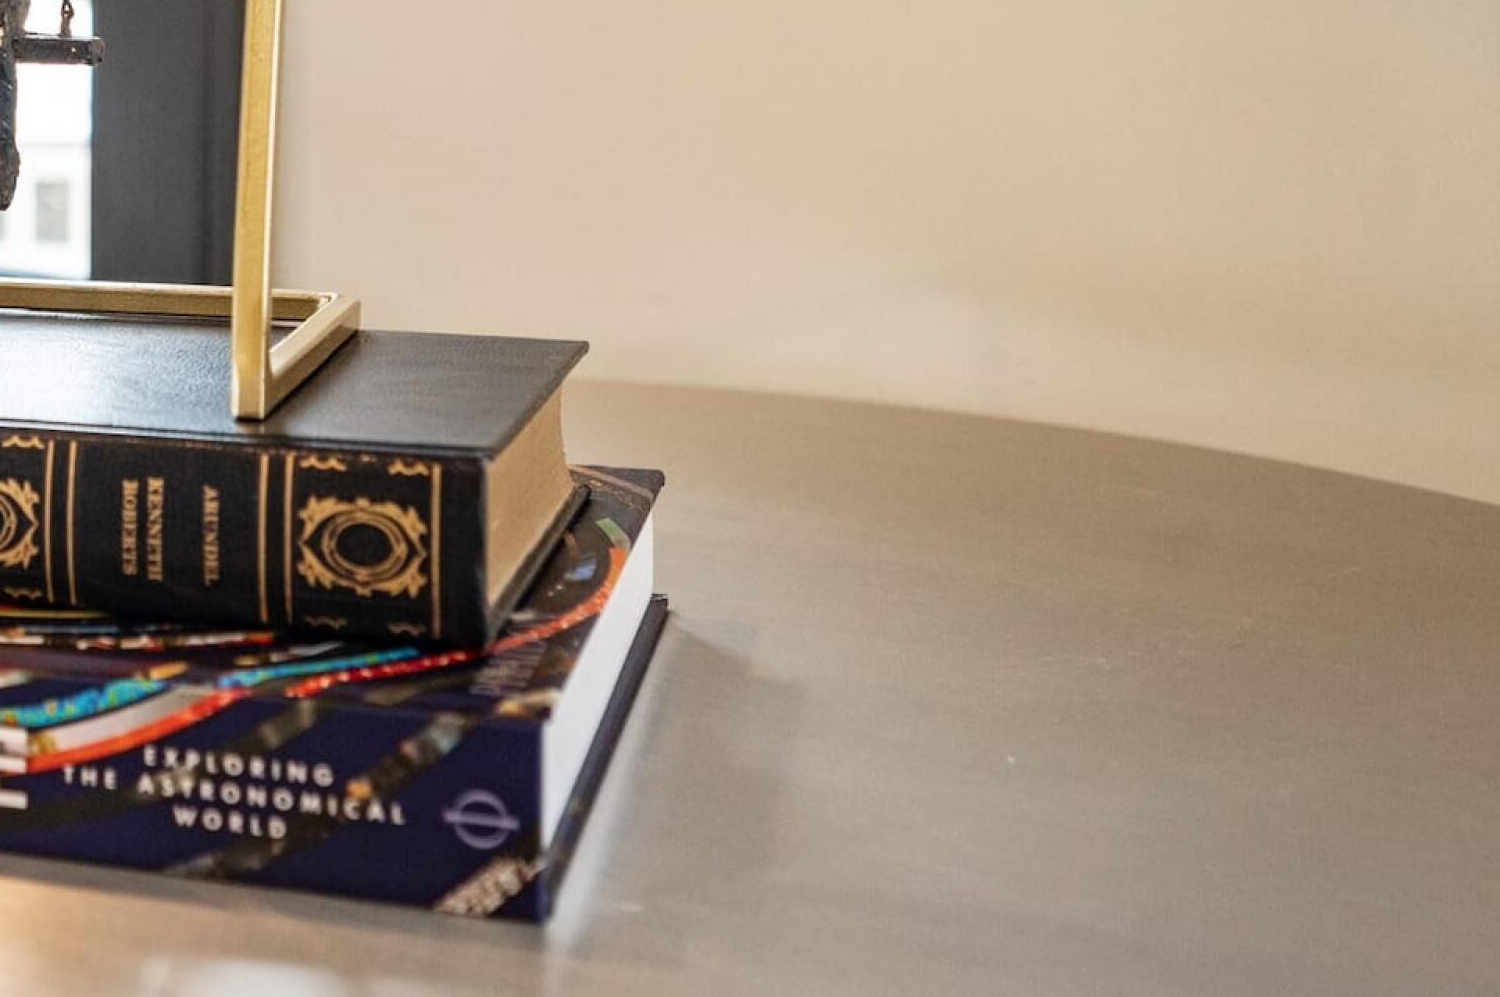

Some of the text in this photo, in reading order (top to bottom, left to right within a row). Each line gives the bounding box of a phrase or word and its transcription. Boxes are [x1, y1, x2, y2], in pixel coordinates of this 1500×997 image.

[121, 479, 139, 575] ROBERTS
[146, 476, 164, 581] KENNETH
[202, 484, 219, 586] ARUNDEL
[63, 764, 405, 826] THE ASTRONOMICAL
[143, 745, 334, 787] EXPLORING
[172, 805, 287, 840] WORLD
